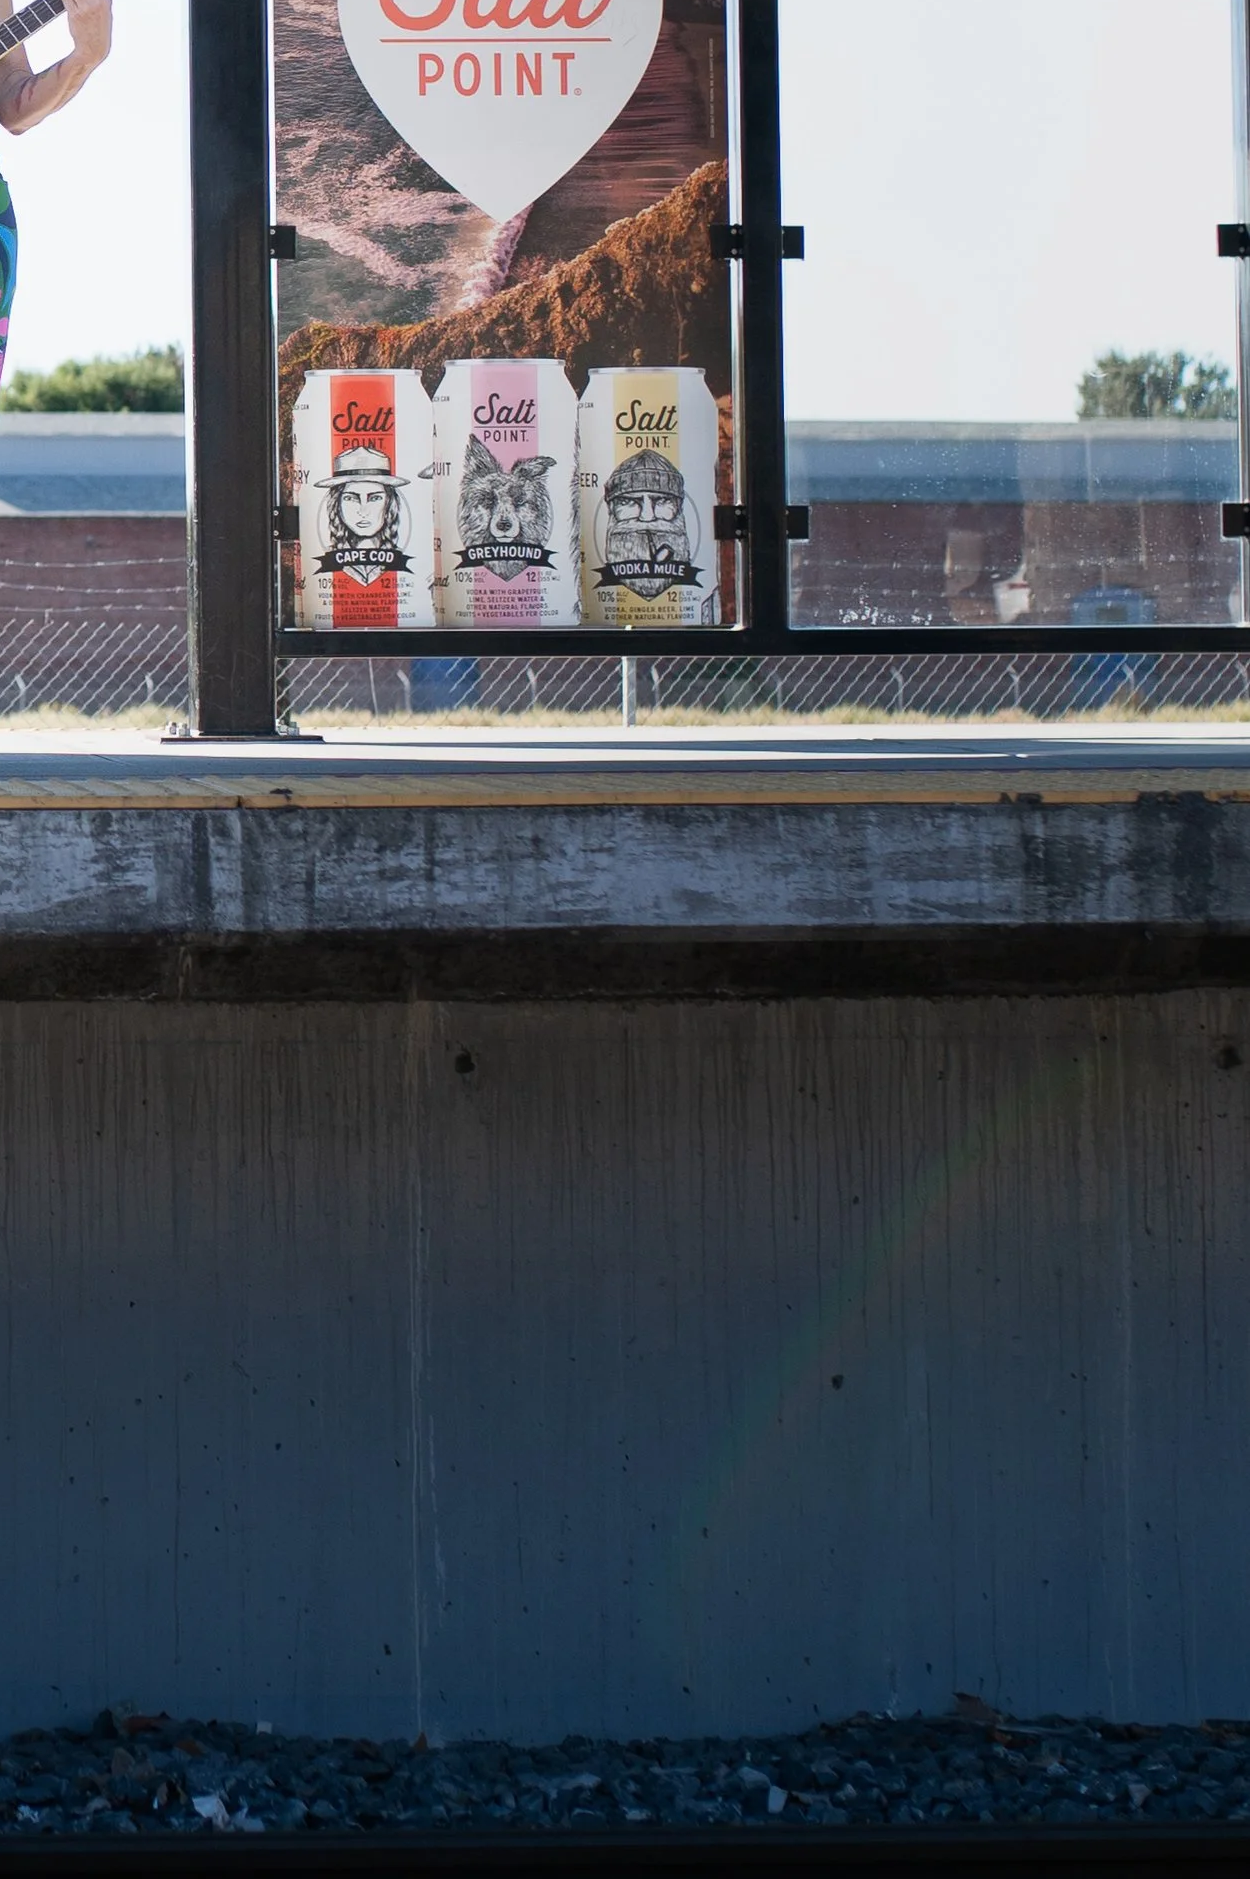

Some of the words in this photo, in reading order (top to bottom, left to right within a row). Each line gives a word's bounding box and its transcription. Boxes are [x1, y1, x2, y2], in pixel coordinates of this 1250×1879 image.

[474, 393, 536, 425] Salt
[616, 399, 678, 432] Salt
[333, 401, 394, 433] Salt
[335, 550, 366, 563] CAPE
[369, 550, 394, 563] COD
[468, 546, 542, 560] GREYHOUND
[612, 563, 650, 576] VODKA
[654, 564, 685, 576] MULE
[454, 572, 473, 582] 10%
[525, 571, 536, 582] 12
[380, 578, 391, 589] 12
[597, 591, 615, 602] 10%
[667, 591, 677, 602] 12
